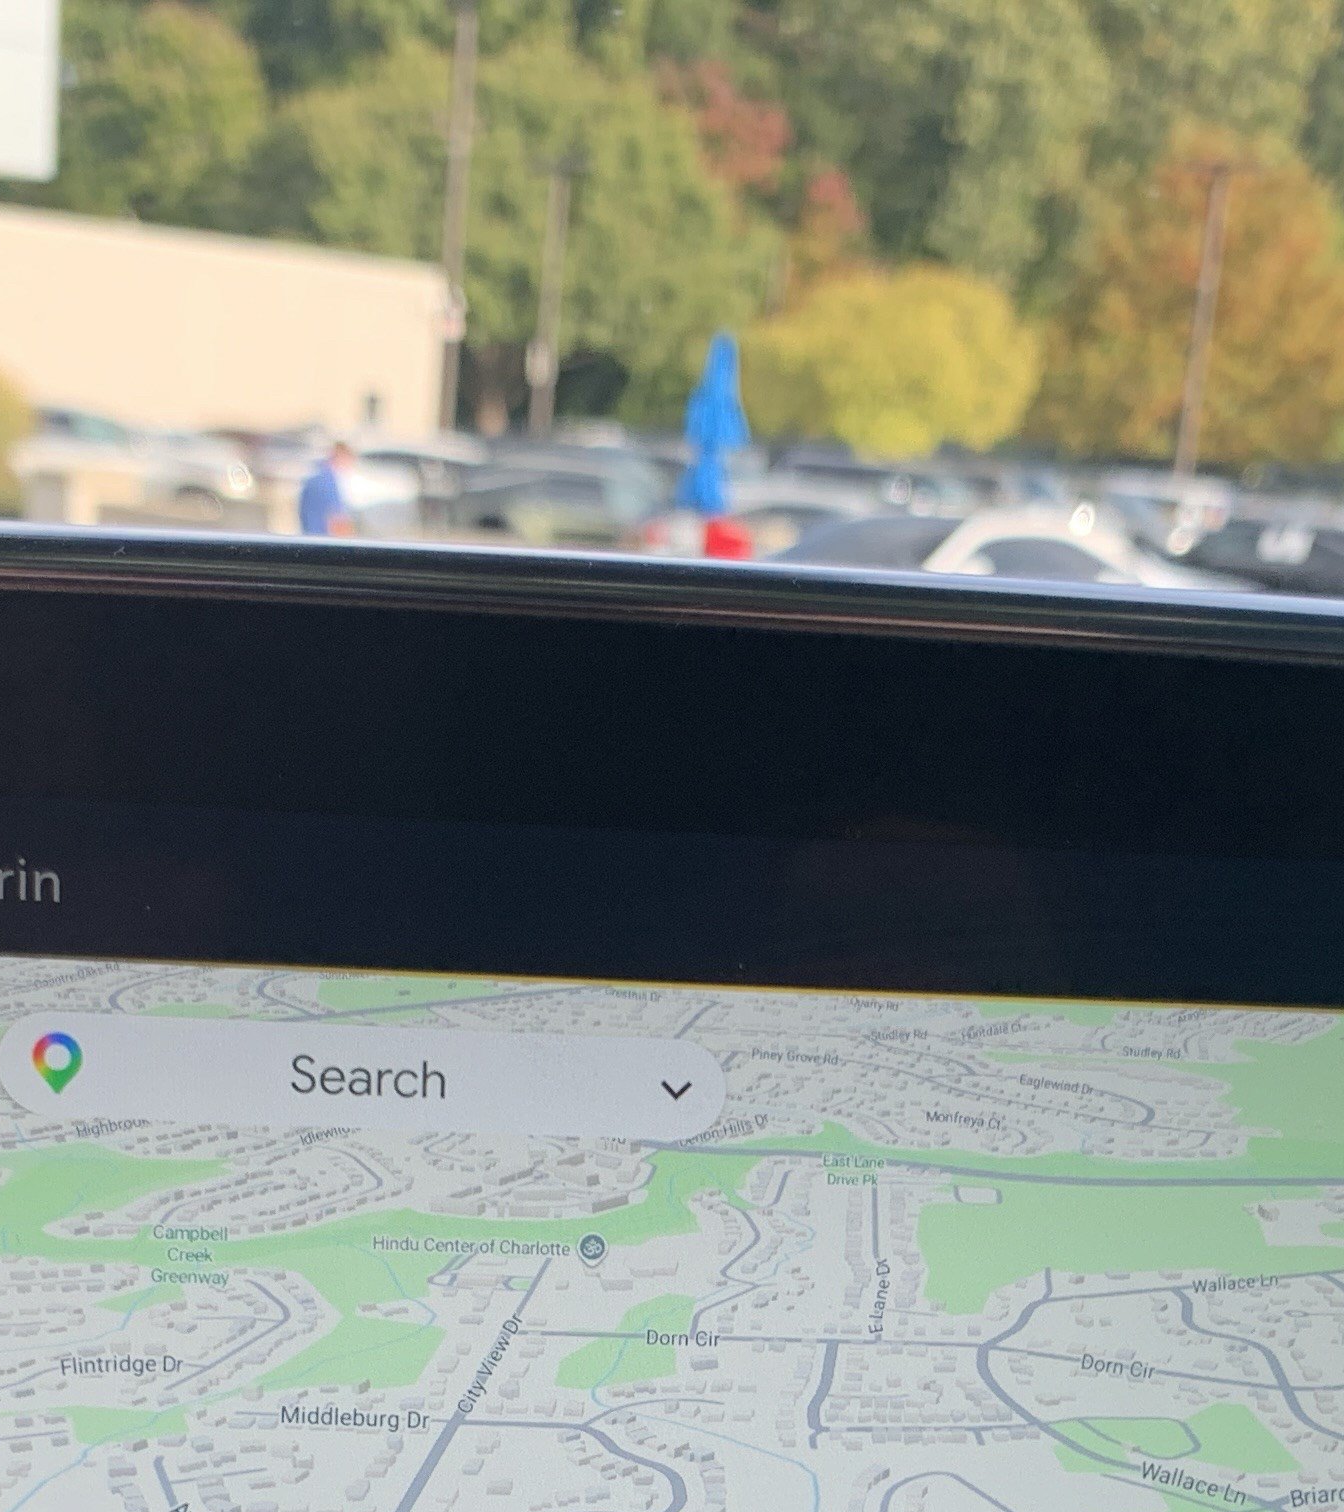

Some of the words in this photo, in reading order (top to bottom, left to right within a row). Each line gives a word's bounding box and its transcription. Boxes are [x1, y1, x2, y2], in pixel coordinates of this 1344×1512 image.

[751, 1048, 783, 1063] Piney
[786, 1051, 820, 1065] Grove
[822, 1053, 840, 1065] Rd
[290, 1054, 446, 1099] Search
[1019, 1073, 1080, 1094] Eaglewind
[1081, 1083, 1096, 1095] Dr
[152, 1225, 228, 1242] Campbell
[166, 1247, 213, 1263] Creek
[372, 1236, 420, 1252] Hindu
[423, 1237, 474, 1253] Center
[475, 1239, 495, 1253] of
[499, 1240, 571, 1257] Charlotte
[150, 1268, 230, 1287] Greenway
[876, 1258, 891, 1276] Dr
[1192, 1276, 1256, 1294] Wallace
[1258, 1274, 1280, 1288] Ln
[869, 1279, 891, 1319] Lane
[645, 1328, 690, 1347] Dorn
[694, 1330, 721, 1347] Cir
[59, 1354, 158, 1377] Flintridge
[163, 1355, 184, 1373] Dr
[457, 1379, 487, 1415] City
[481, 1333, 511, 1377] View
[502, 1314, 524, 1337] Dr
[1080, 1353, 1124, 1373] Dorn
[1129, 1360, 1156, 1380] Cir
[280, 1406, 401, 1433] Middleburg
[406, 1410, 431, 1430] Dr
[1139, 1461, 1219, 1498] Wallace
[1223, 1487, 1248, 1506] Ln
